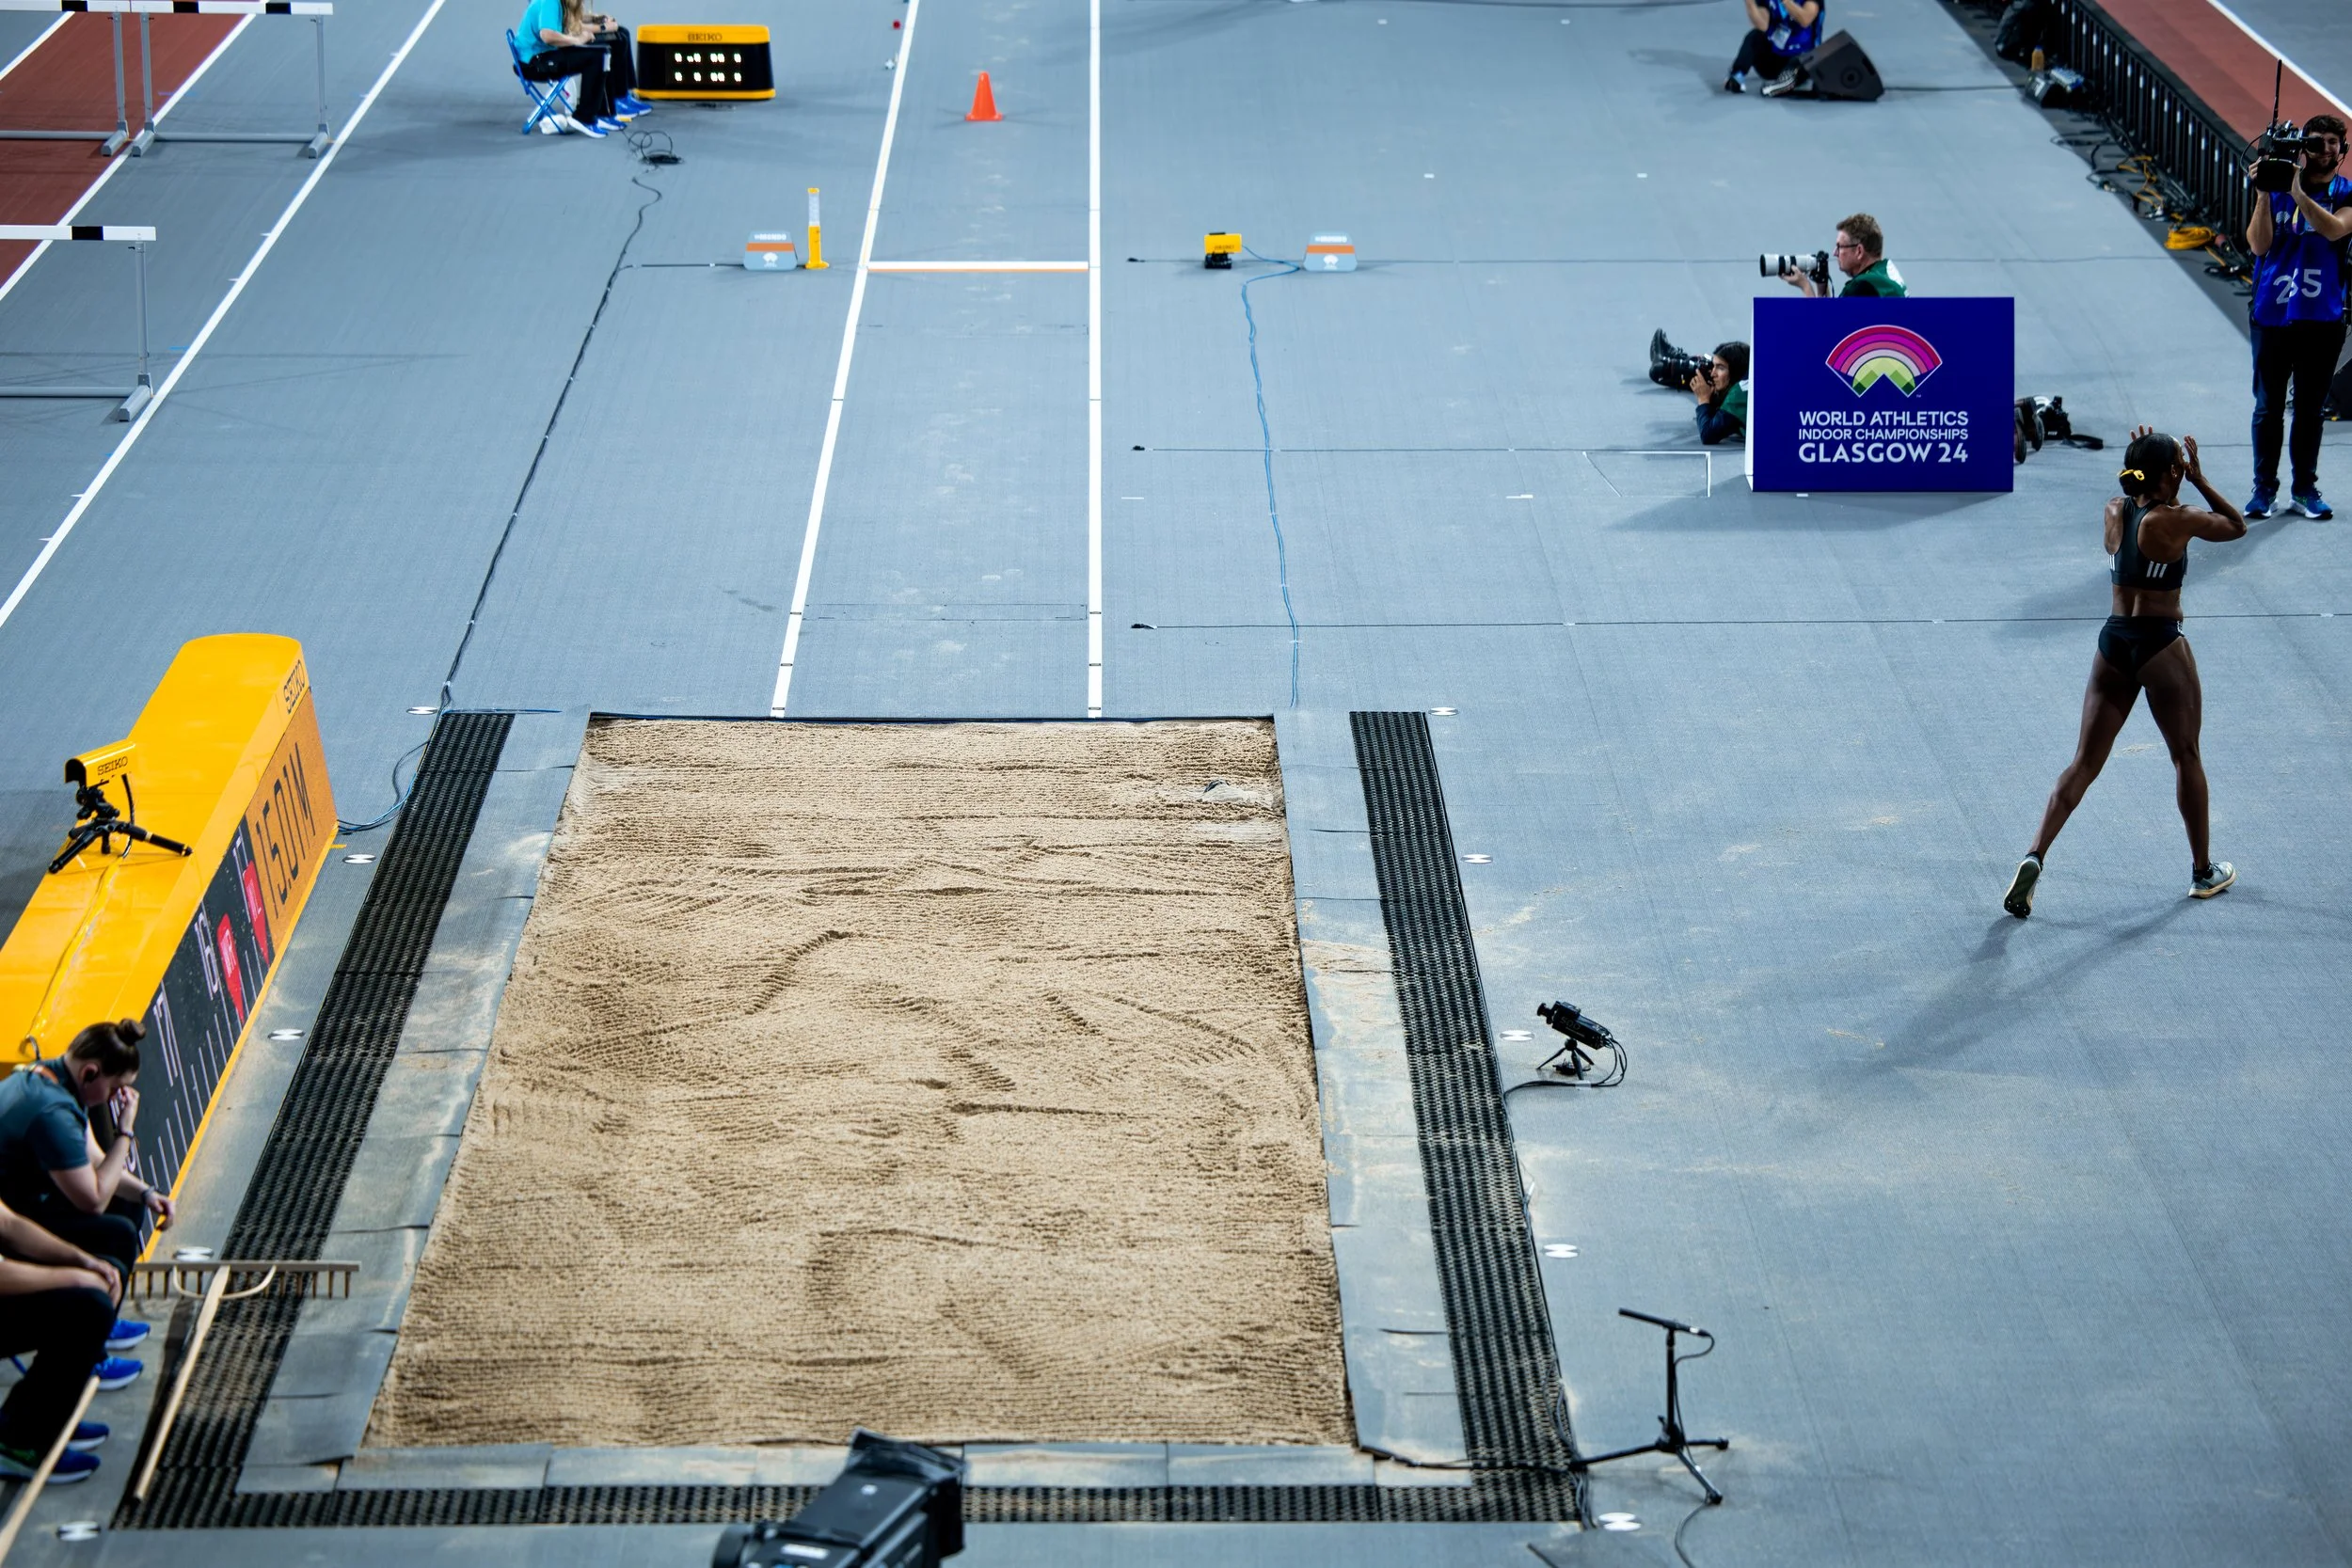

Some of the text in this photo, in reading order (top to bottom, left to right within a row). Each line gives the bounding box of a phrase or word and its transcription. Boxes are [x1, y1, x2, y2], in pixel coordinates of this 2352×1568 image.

[687, 32, 723, 41] SEIKO
[1799, 410, 1969, 426] WORLD ATHLETICS
[1798, 428, 1969, 440] INDOOR CHAMPIONSHIPS
[1798, 442, 1969, 463] GLASGOW 24
[283, 658, 306, 715] SEIKO
[97, 756, 129, 776] SEIKO
[194, 911, 218, 1001] 16
